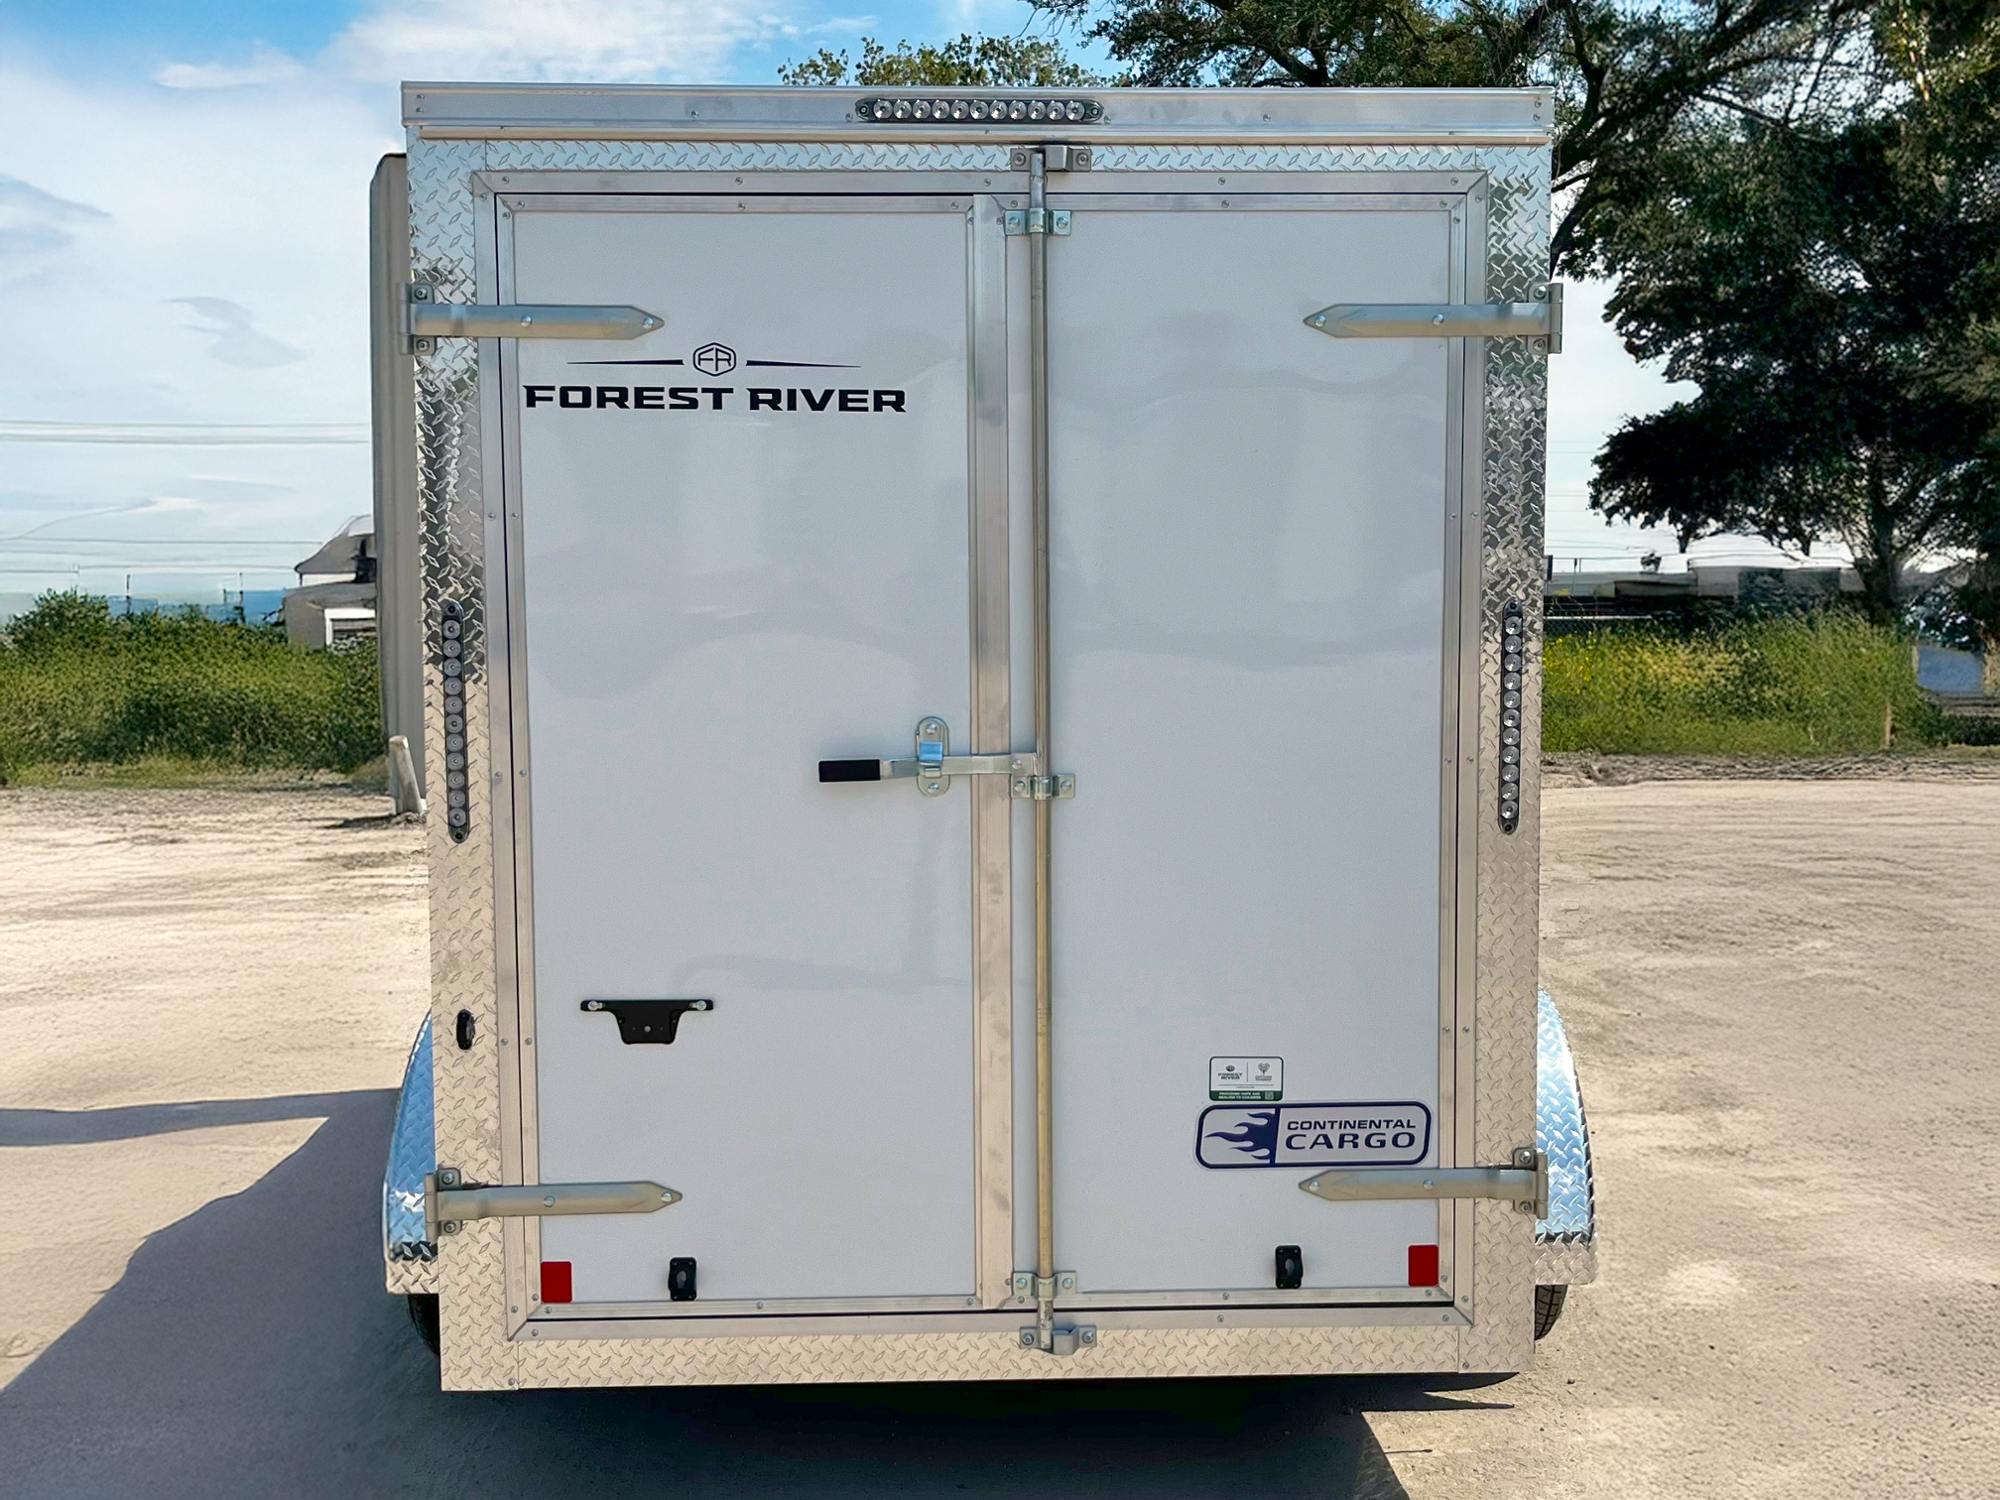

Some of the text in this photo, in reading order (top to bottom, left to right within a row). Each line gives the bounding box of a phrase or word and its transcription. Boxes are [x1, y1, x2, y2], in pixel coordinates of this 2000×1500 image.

[522, 384, 907, 413] FOREST RIVER
[1287, 1118, 1416, 1131] CONTINENTAL
[1285, 1131, 1416, 1150] CARGO
